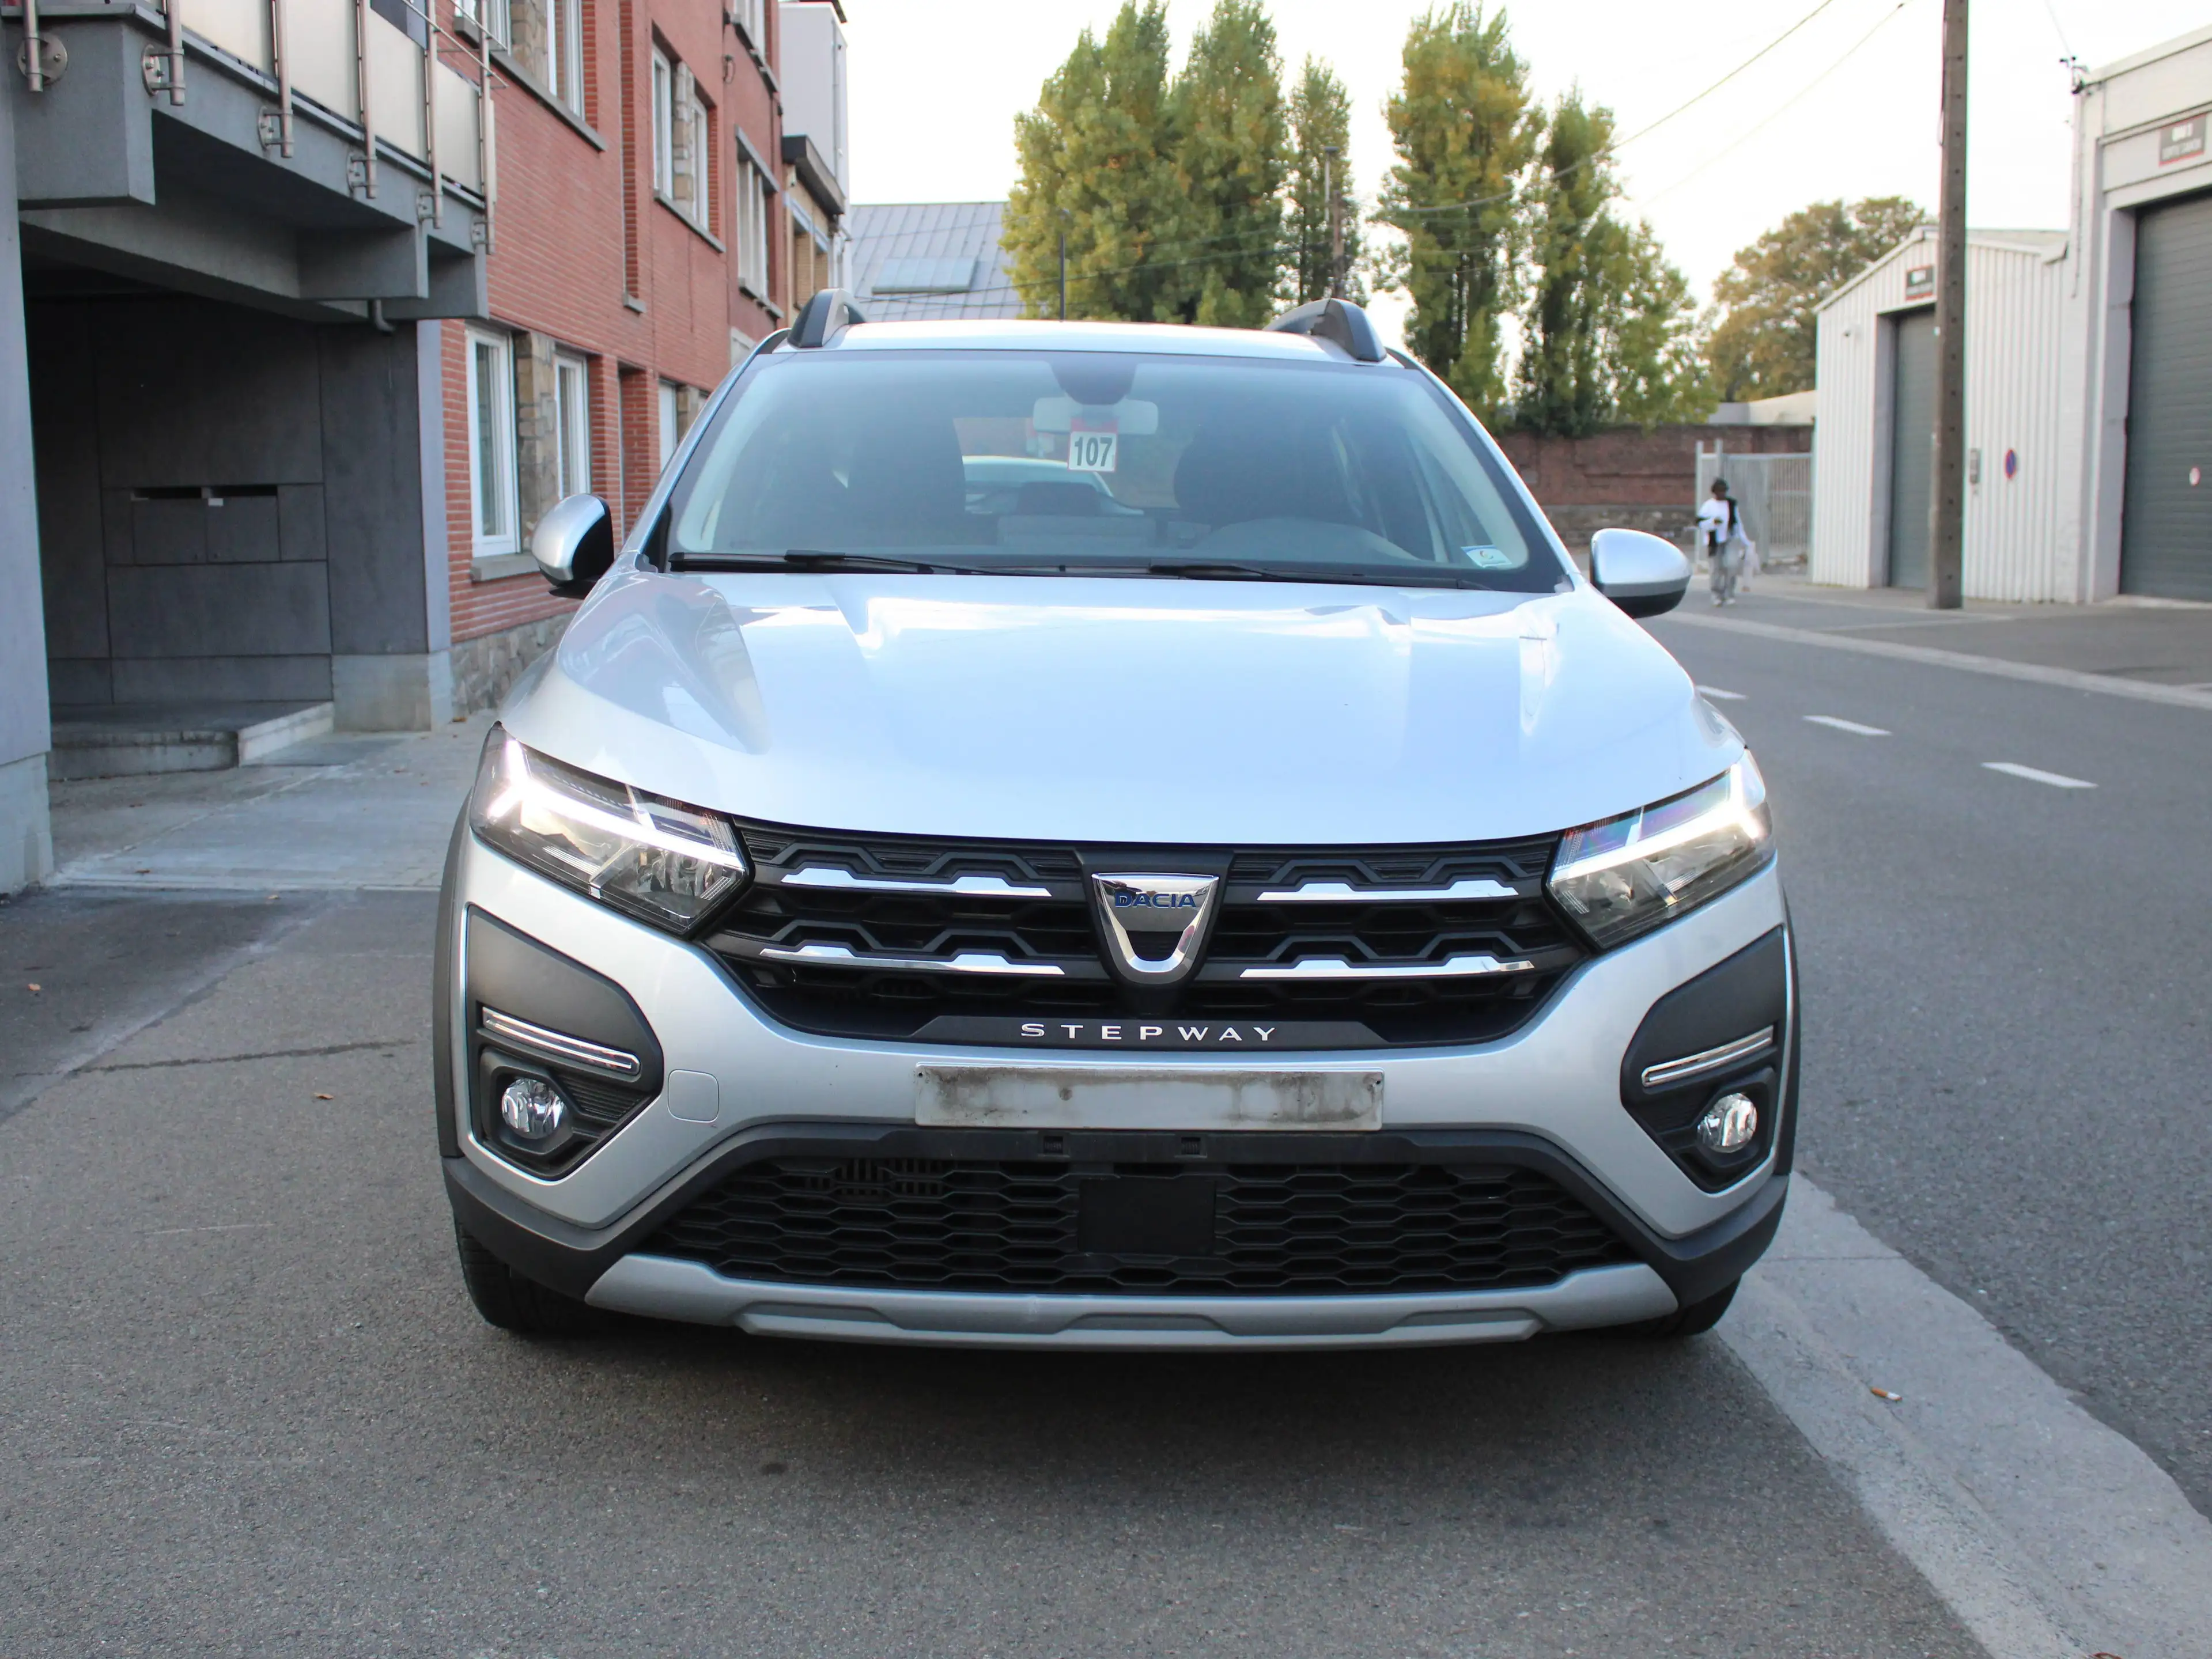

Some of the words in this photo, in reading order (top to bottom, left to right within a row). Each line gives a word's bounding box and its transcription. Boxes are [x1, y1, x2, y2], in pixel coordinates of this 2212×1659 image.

[1075, 437, 1113, 467] 107
[1114, 893, 1197, 908] DACIA
[1020, 1023, 1276, 1041] STEPWAY
